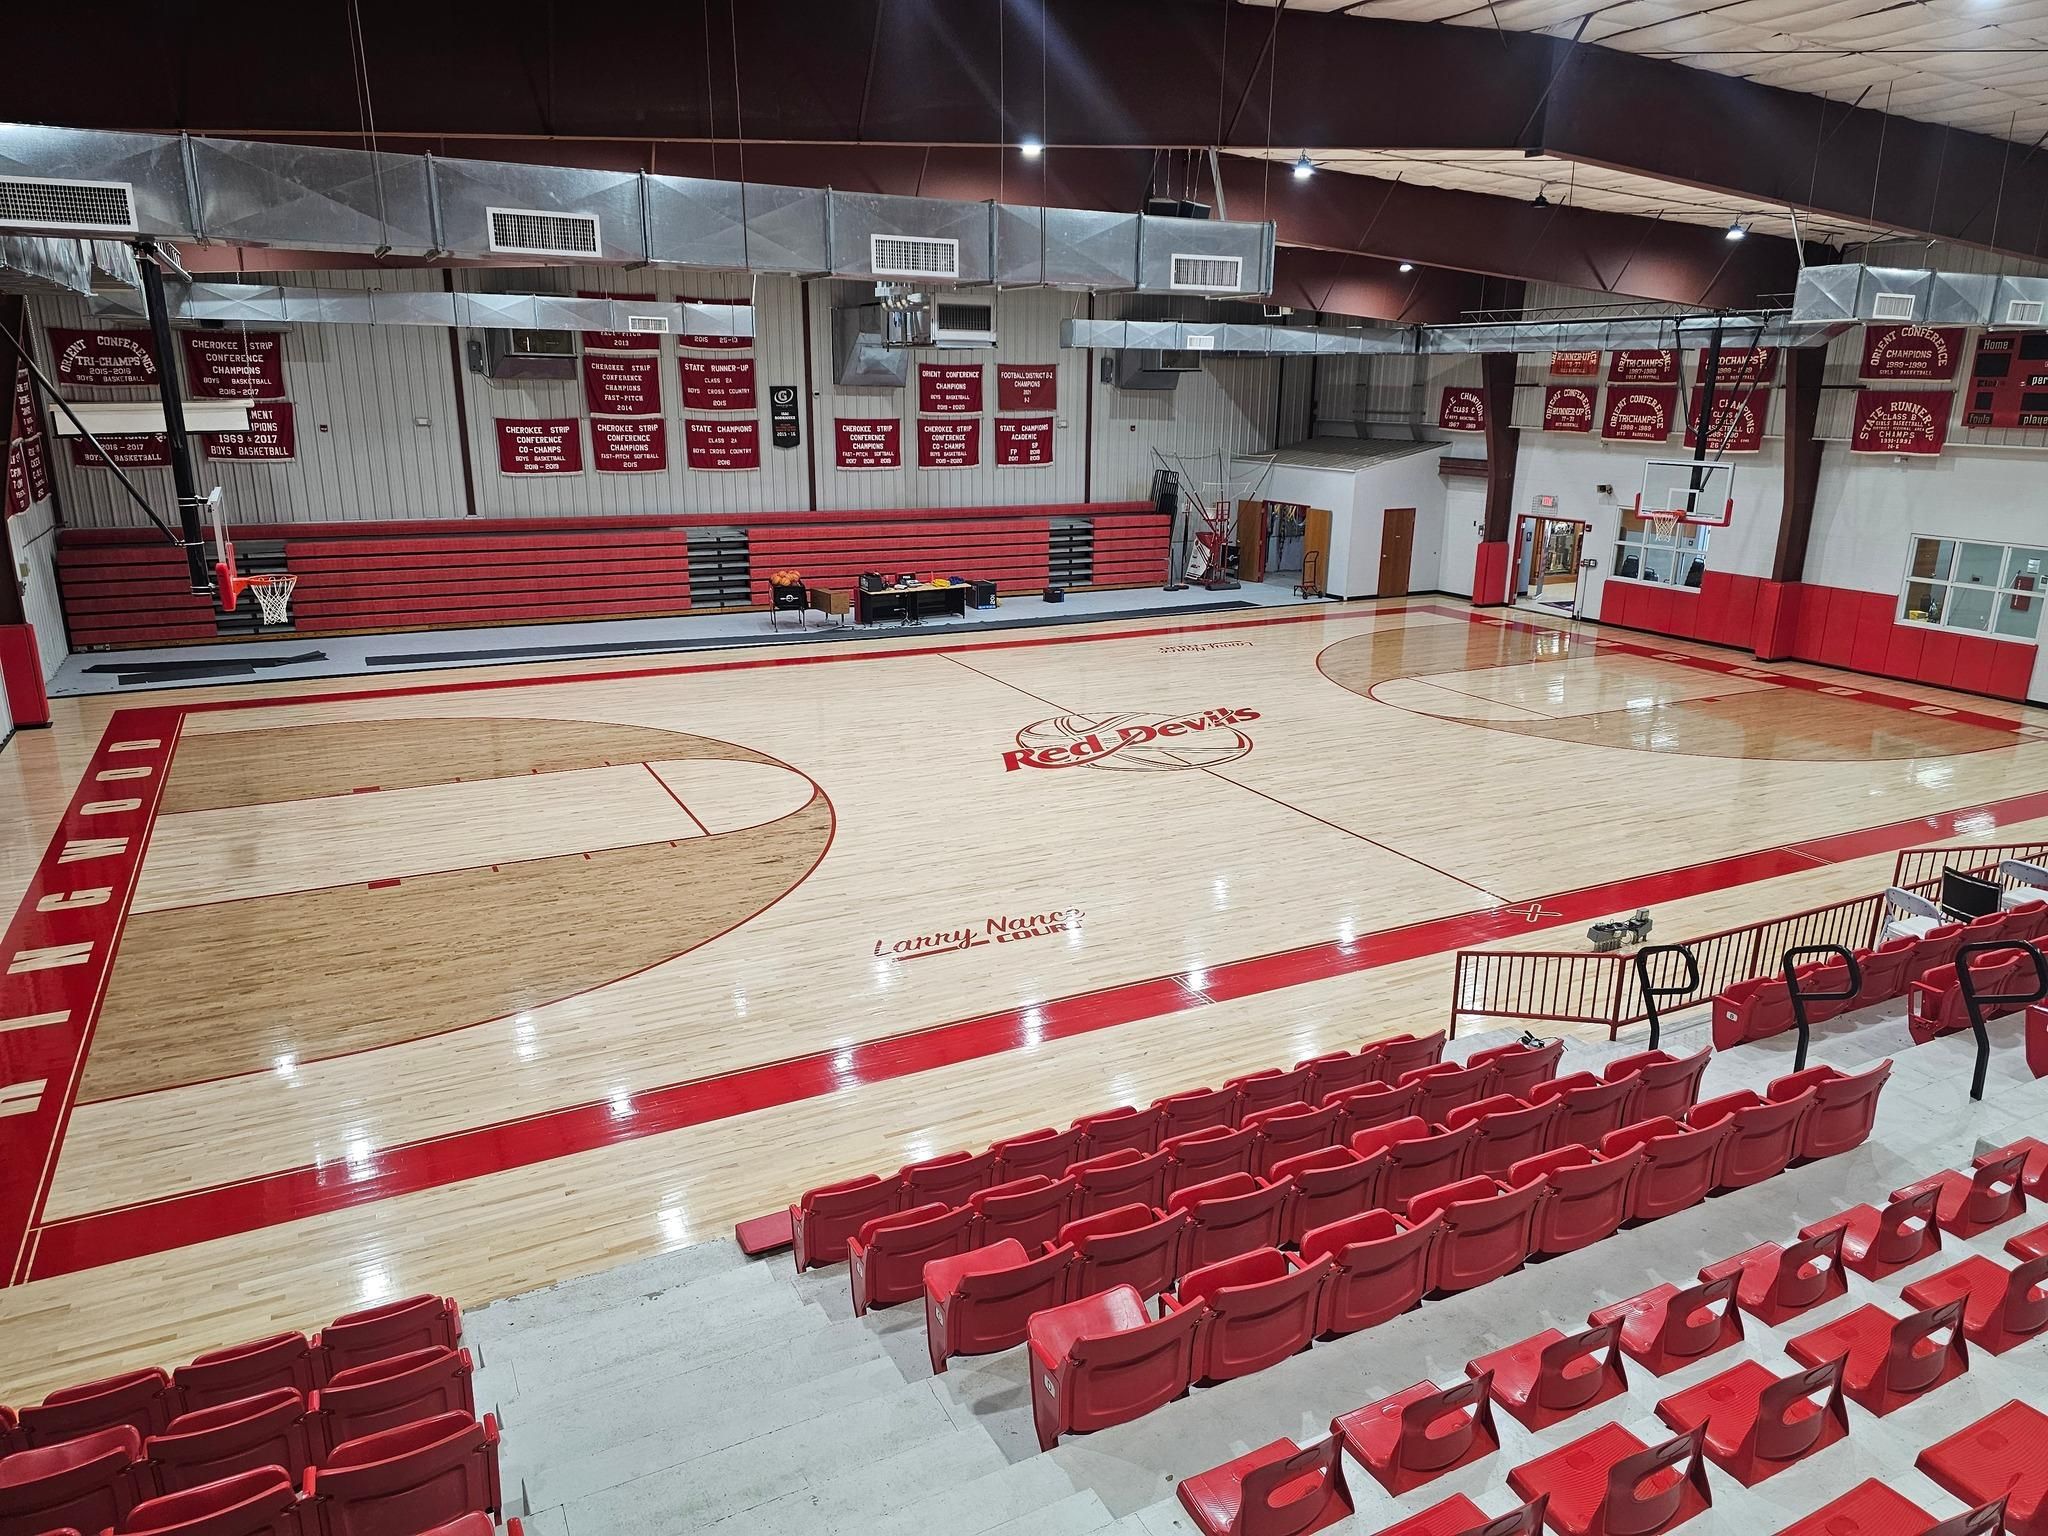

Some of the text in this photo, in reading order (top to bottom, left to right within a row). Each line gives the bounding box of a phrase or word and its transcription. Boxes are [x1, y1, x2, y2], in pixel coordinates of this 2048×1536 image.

[192, 340, 238, 349] CHEROKEE
[1871, 327, 1948, 367] ORIENT CONFERENCE
[1984, 340, 2008, 350] Home
[61, 336, 156, 374] ORIENT CONFERENCE
[206, 354, 264, 362] CONFERENCE
[1886, 350, 1932, 359] CHAMPIONS
[75, 356, 140, 366] TRI-CHAMPS
[213, 366, 261, 374] CHAMPIONS
[592, 363, 624, 371] CHEROKEE
[685, 363, 705, 372] STATE
[1460, 393, 1483, 422] CHAMPIONS
[1546, 389, 1591, 421] ORIENT CONFERENCE
[250, 411, 273, 419] MENT
[1552, 408, 1584, 416] RUNNER-UP
[1610, 397, 1627, 427] ORIENT
[1630, 395, 1664, 429] CONFERENCE
[1860, 401, 1934, 441] STATE RUNNER-UP
[1882, 413, 1907, 421] CLASS
[506, 426, 570, 434] CHEROKEE STRIP
[598, 424, 658, 432] CHEROKEE STRIP
[691, 425, 712, 433] STATE
[1022, 424, 1049, 432] CHAMPIONS
[219, 435, 244, 444] 1969
[254, 435, 278, 444] 2017
[1879, 431, 1915, 439] CHAMPS
[517, 436, 562, 444] CONFERENCE
[211, 446, 289, 455] BOYS BASKETBALL
[1001, 707, 1261, 772] Red Devils
[874, 906, 1086, 957] Larry Nance
[997, 919, 1083, 944] COURT
